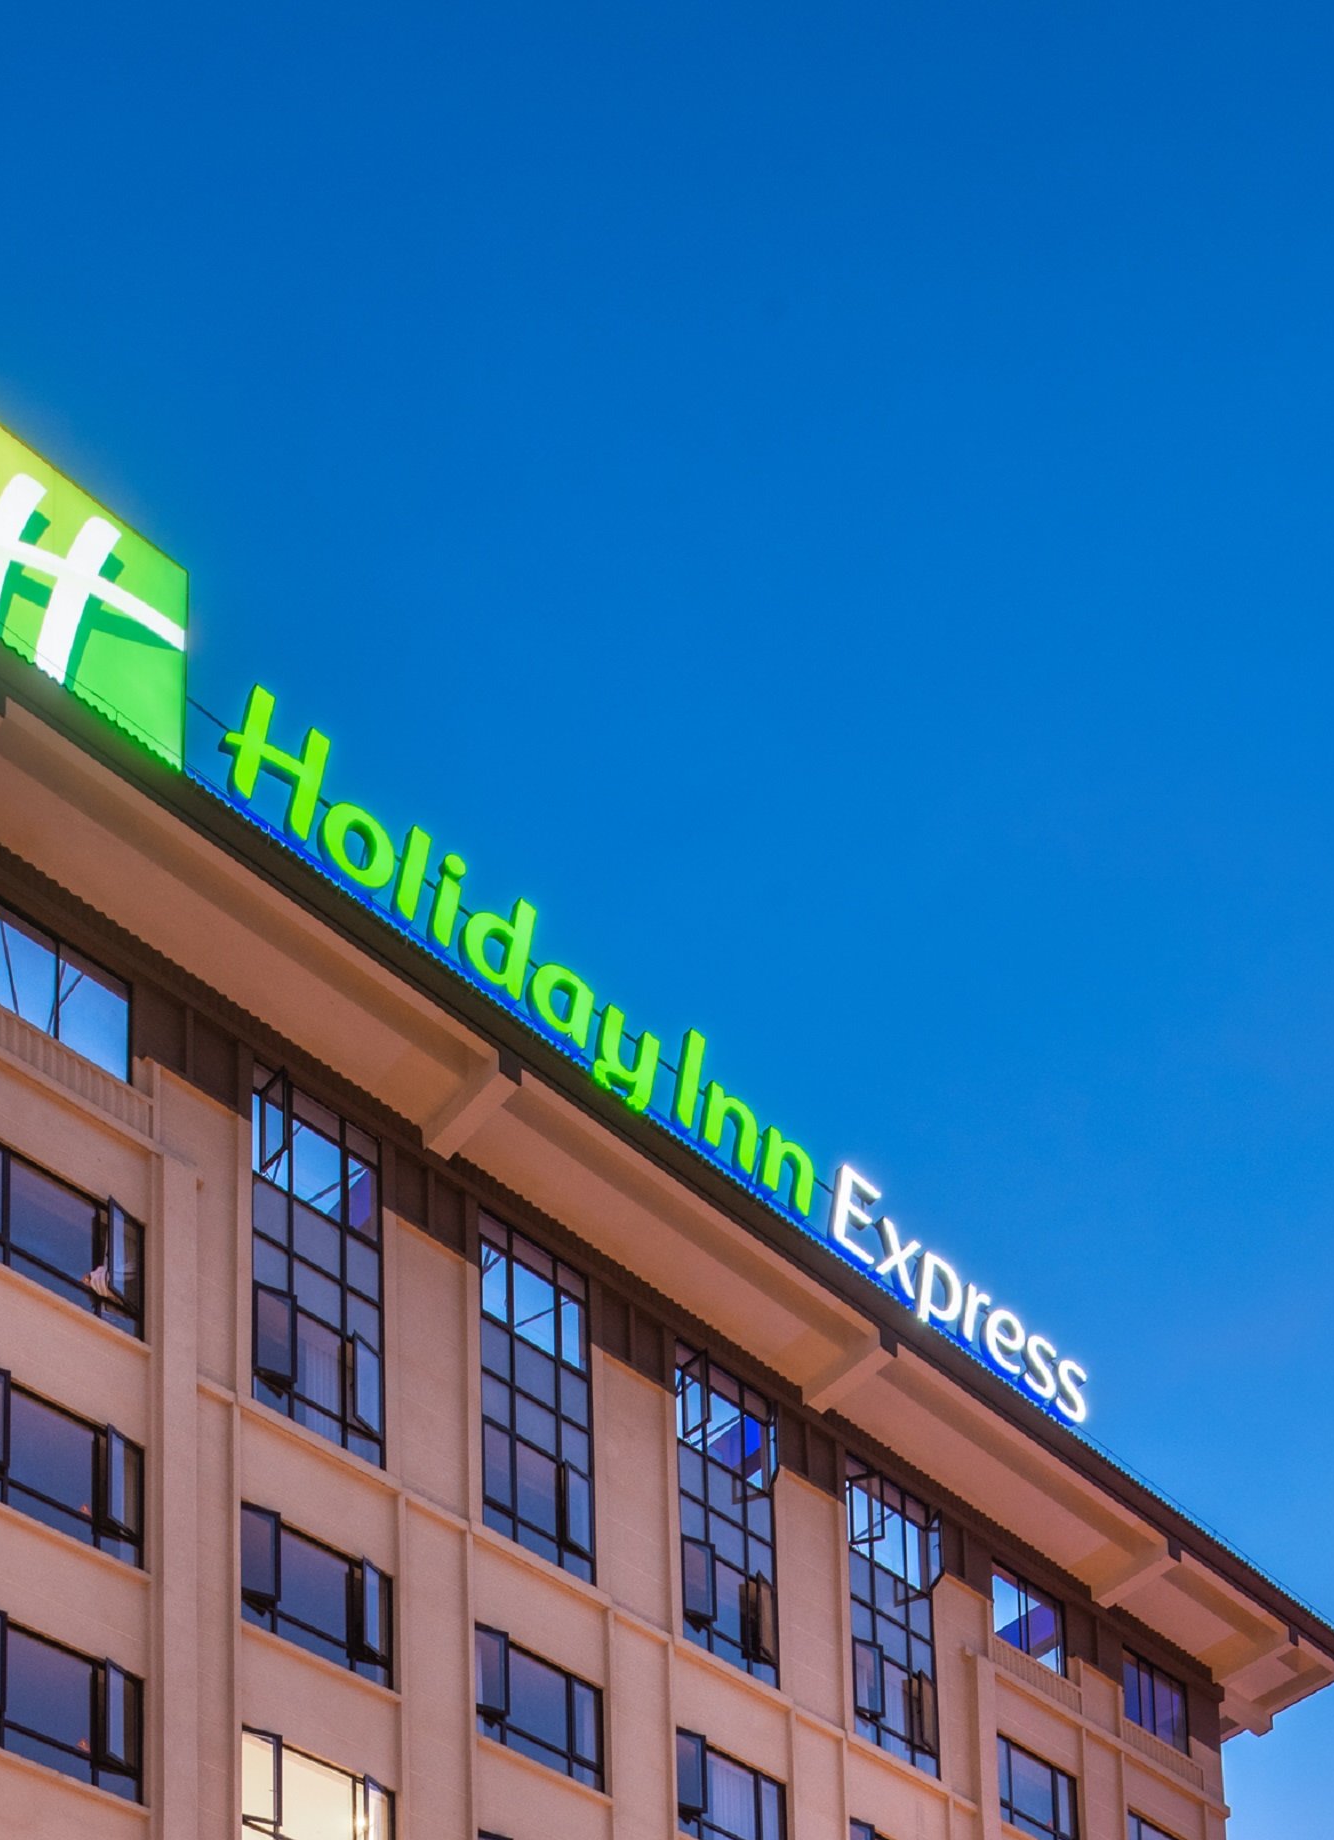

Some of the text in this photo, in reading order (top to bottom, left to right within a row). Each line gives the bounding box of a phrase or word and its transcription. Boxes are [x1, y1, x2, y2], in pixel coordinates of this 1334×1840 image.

[220, 683, 1089, 1427] Holiday Inn Express
